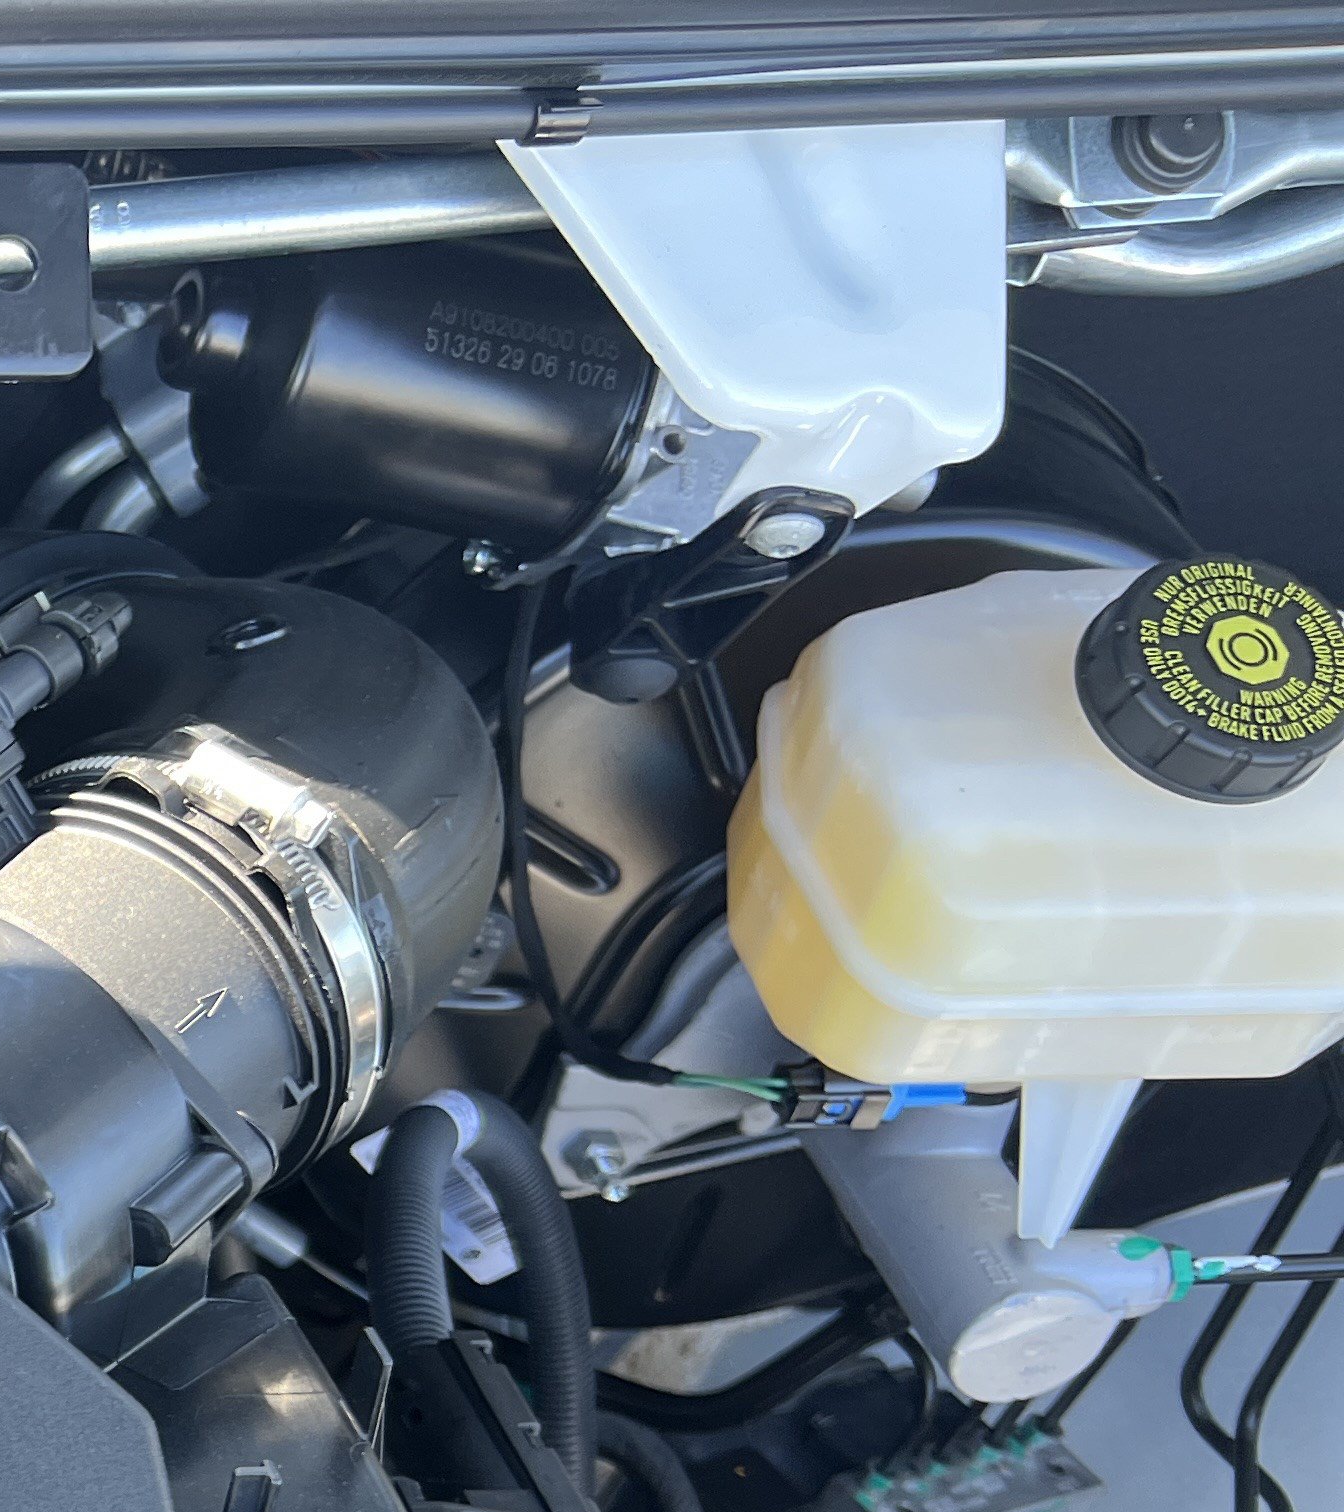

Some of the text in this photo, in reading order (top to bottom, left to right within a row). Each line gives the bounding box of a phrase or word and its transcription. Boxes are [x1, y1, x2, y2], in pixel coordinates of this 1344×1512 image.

[424, 327, 619, 391] 51326 29 06 1078
[1153, 562, 1255, 602] NUR ORIGINAL
[1182, 595, 1273, 635] VERWENDEN
[1283, 582, 1344, 647] CONTAINER
[1140, 619, 1160, 644] USE
[1143, 647, 1172, 680] ONLY
[1164, 614, 1334, 724] CLEAN FILLER CAP BEFORE REMOVING
[1240, 676, 1307, 706] WARNING
[1207, 712, 1259, 741] BRAKE
[1262, 722, 1306, 742] FLUID
[1302, 702, 1339, 734] FROM
